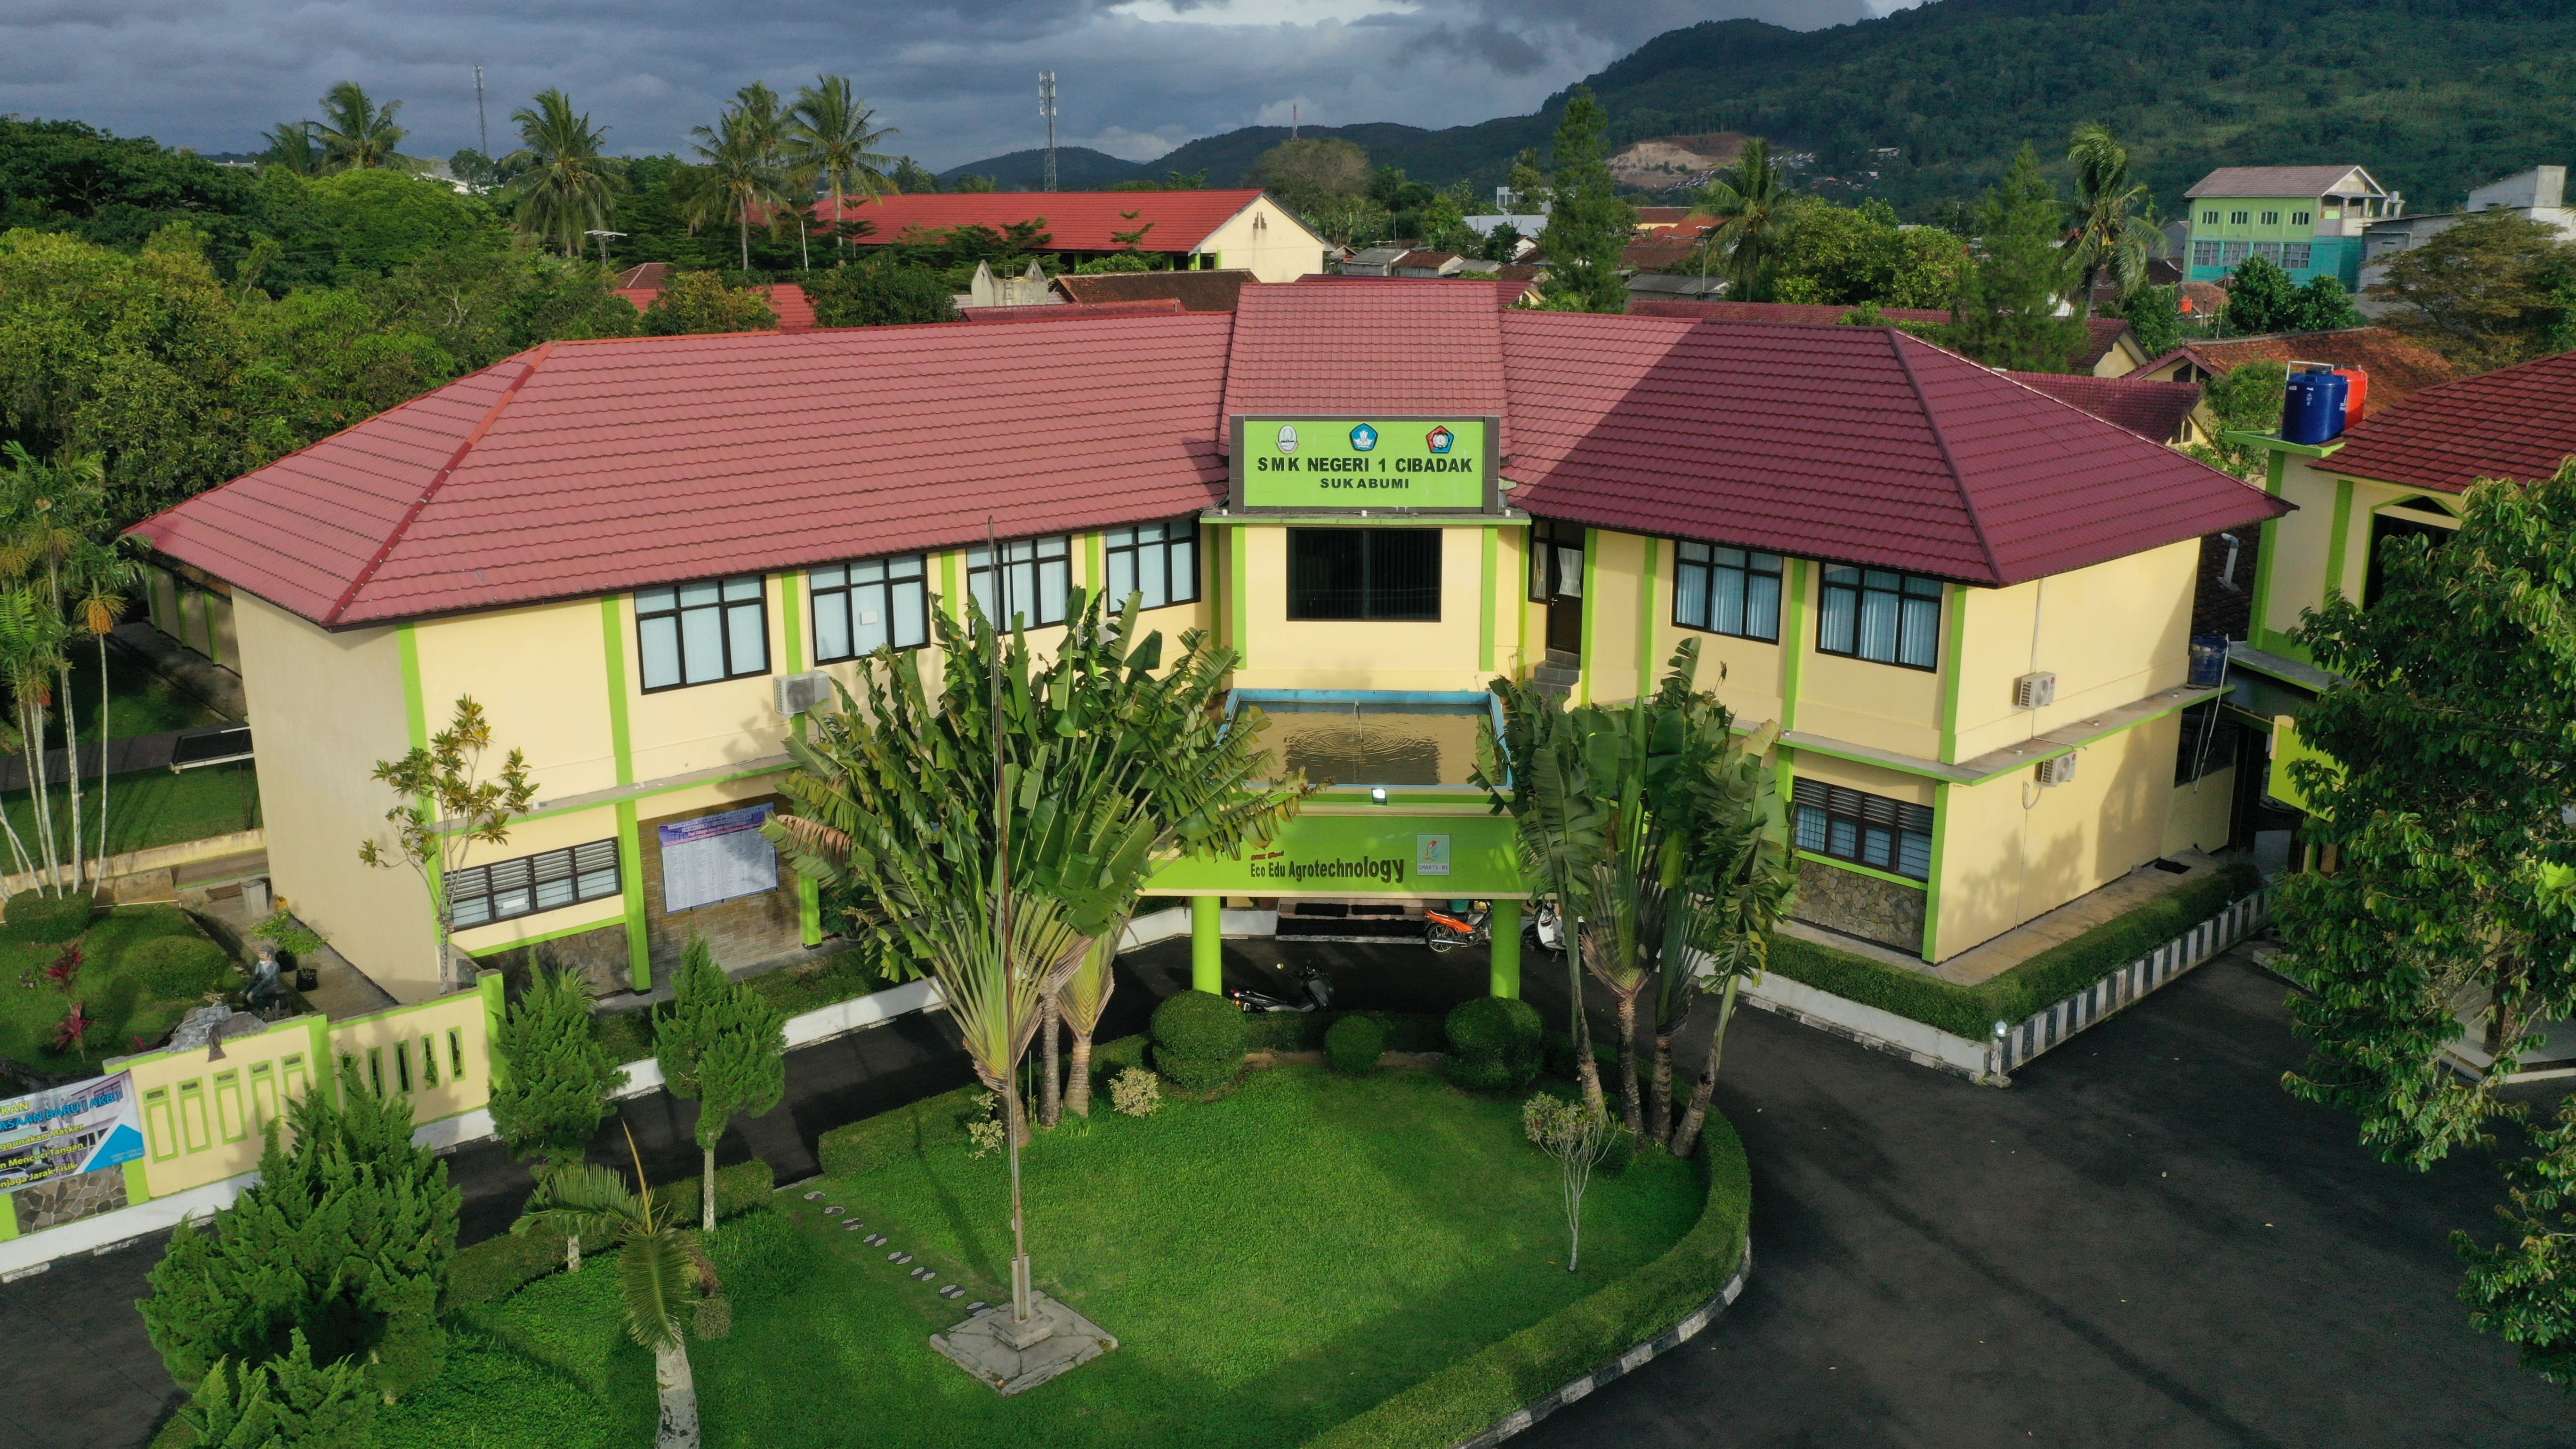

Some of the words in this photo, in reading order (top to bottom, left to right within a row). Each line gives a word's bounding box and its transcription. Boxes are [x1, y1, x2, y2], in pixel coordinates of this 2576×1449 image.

[1257, 457, 1300, 472] SMK
[1307, 457, 1369, 472] NEGERI
[1378, 458, 1385, 472] 1
[1395, 457, 1473, 473] CIBADAK
[1320, 478, 1409, 489] SUKABUMI
[1251, 863, 1265, 877] Eco
[1268, 861, 1285, 877] Edu
[1288, 855, 1404, 883] Agrotechnology
[45, 1103, 80, 1120] BARU
[49, 1124, 84, 1138] Masker
[8, 1151, 47, 1167] Mencuci
[49, 1143, 83, 1156] Tangan
[29, 1168, 54, 1181] Jarak
